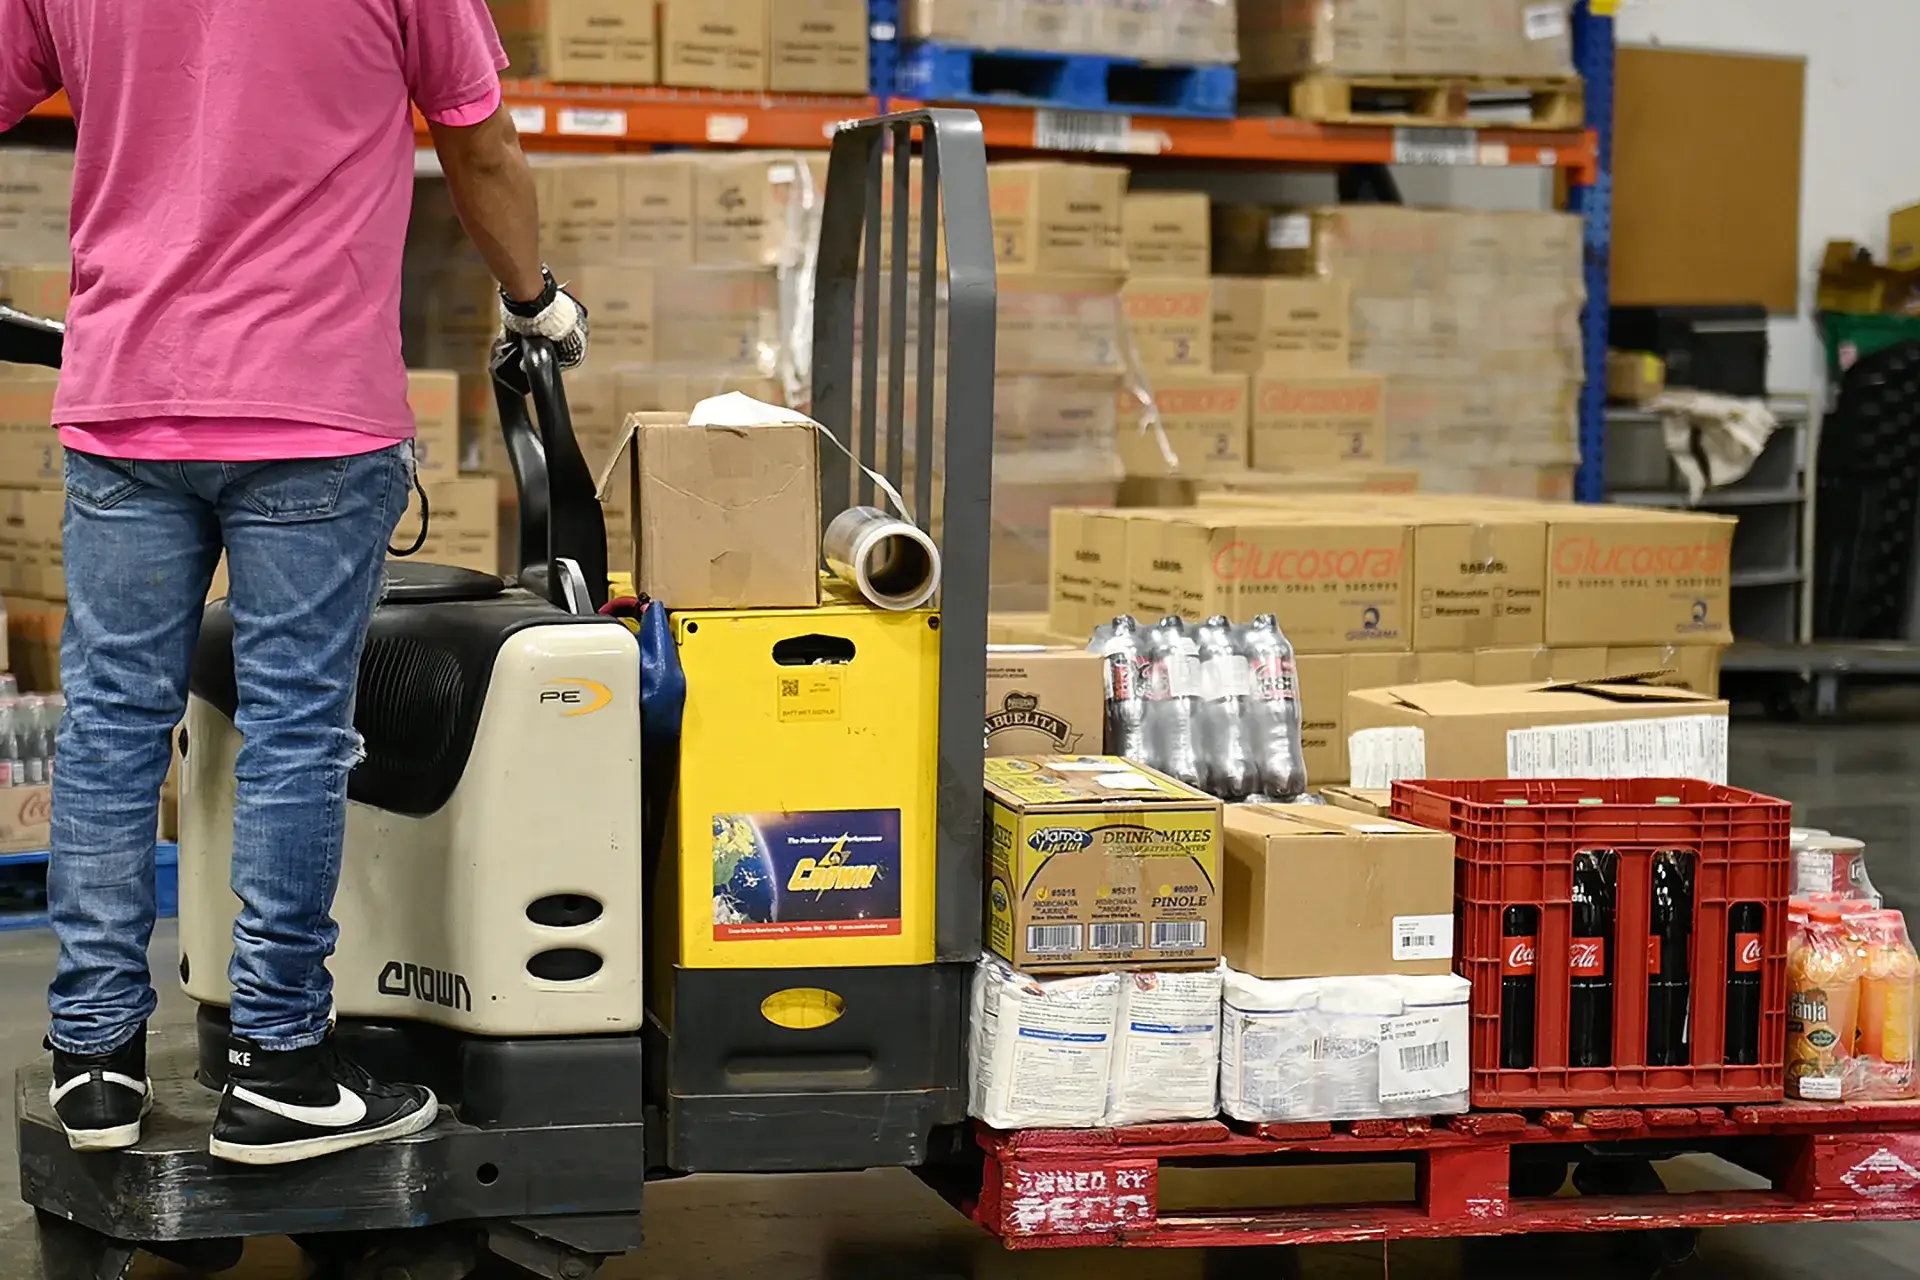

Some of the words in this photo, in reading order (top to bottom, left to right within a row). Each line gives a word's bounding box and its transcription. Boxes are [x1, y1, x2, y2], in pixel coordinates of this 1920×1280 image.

[1212, 540, 1405, 581] Glucosoral
[1554, 536, 1731, 575] Glucosoral
[540, 691, 581, 704] PE
[1103, 831, 1154, 844] DRINK
[1161, 829, 1212, 842] MIXES
[1151, 895, 1208, 908] PINOLE
[1570, 944, 1599, 967] ola
[378, 961, 471, 1012] CROWN
[1788, 1001, 1827, 1023] ranja
